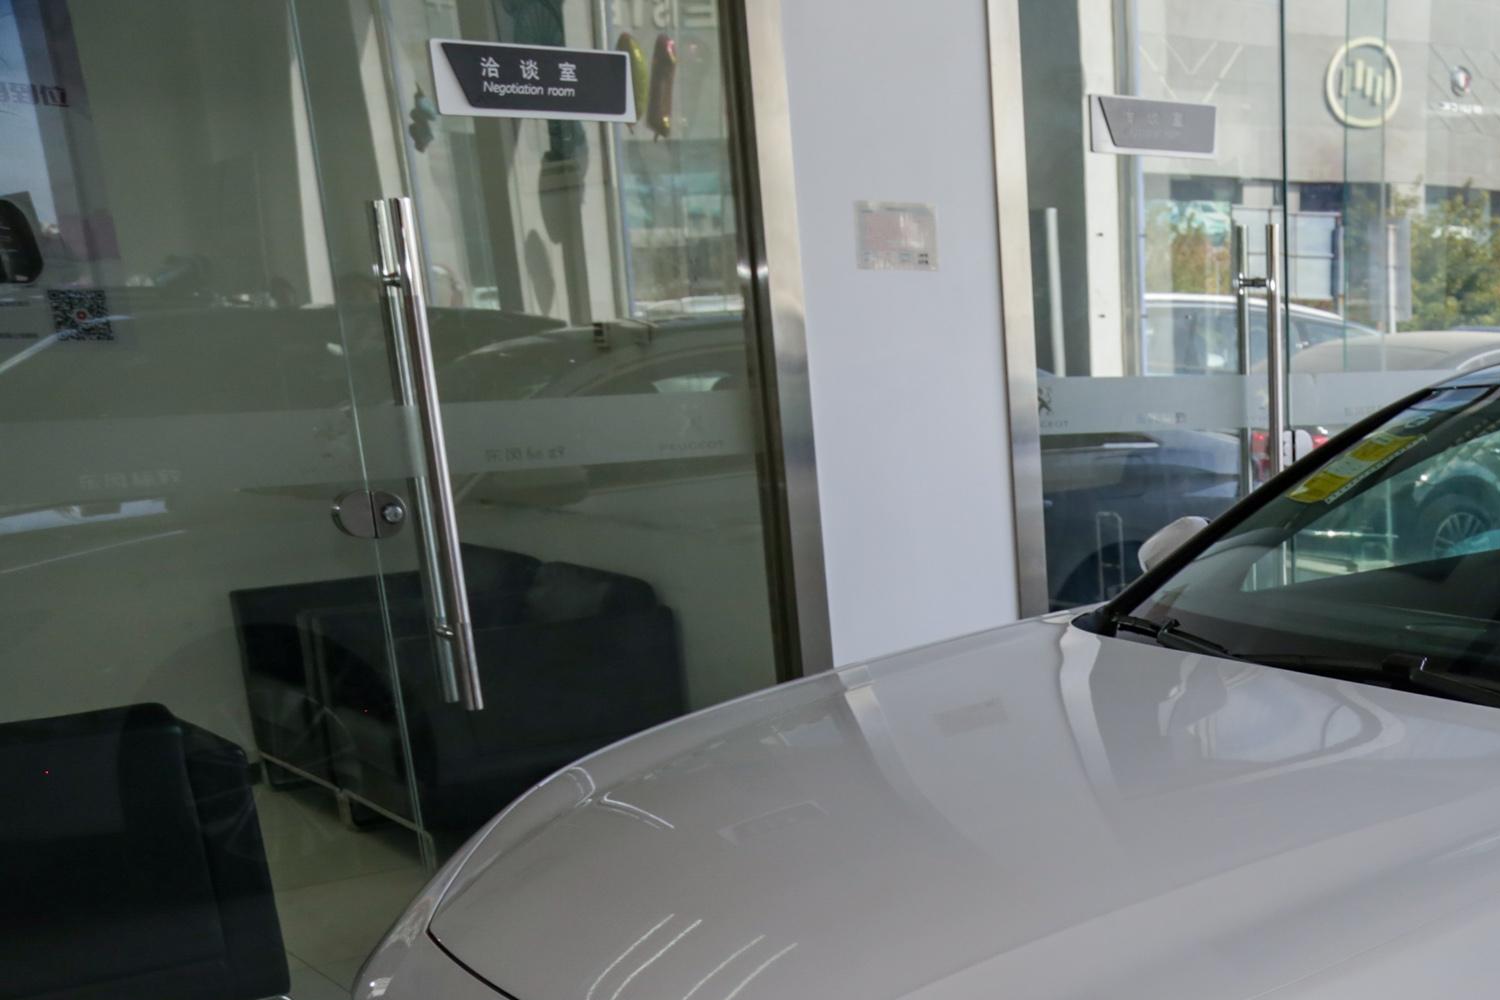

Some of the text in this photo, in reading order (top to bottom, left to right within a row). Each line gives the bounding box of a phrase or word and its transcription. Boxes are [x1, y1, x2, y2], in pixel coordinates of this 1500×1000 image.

[480, 57, 578, 82] 洽谈室
[483, 81, 575, 97] Negotiation room
